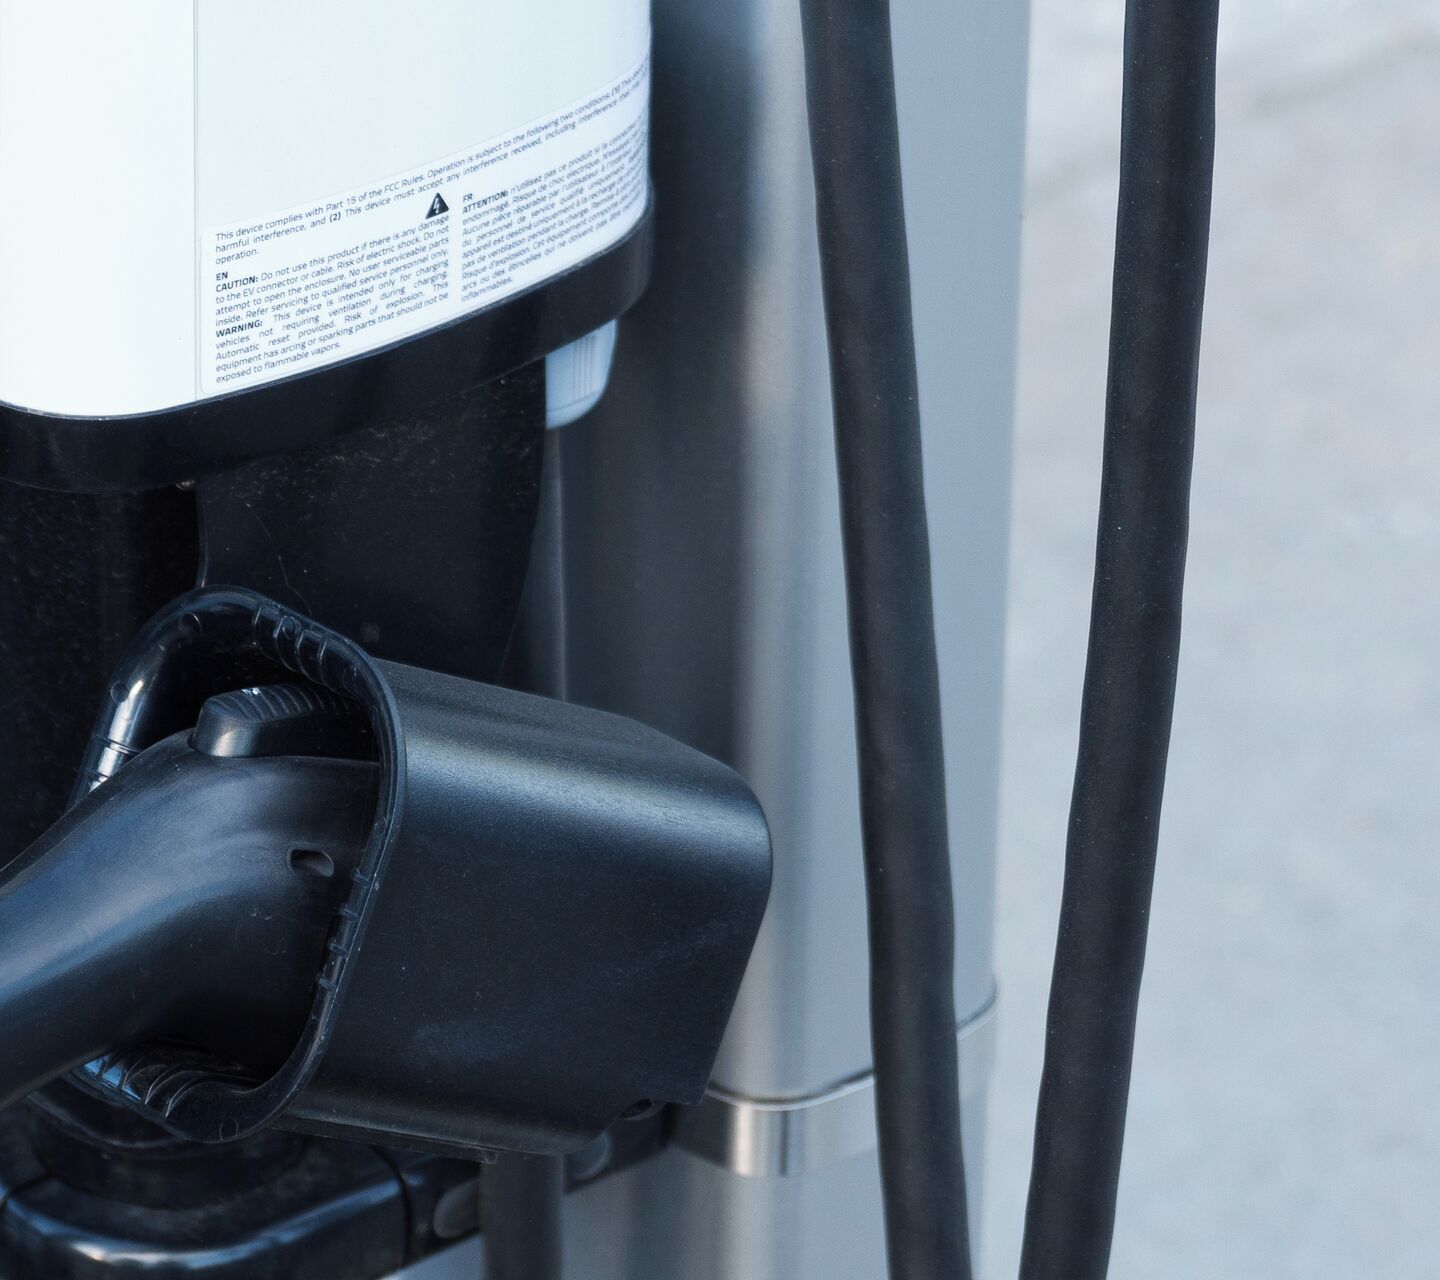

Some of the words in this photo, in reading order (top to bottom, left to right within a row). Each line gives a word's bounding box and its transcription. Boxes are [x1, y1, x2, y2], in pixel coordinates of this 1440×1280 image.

[215, 237, 249, 252] harmful
[309, 216, 326, 227] and
[328, 211, 341, 222] (2)
[342, 206, 363, 216] This
[364, 197, 392, 210] device
[393, 188, 416, 200] must
[417, 177, 444, 192] accept
[445, 172, 461, 182] any
[462, 152, 508, 174] interference
[216, 231, 234, 240] This
[235, 224, 263, 236] device
[264, 213, 304, 229] complies
[304, 207, 324, 217] with
[325, 200, 344, 211] Part
[368, 189, 382, 198] the
[383, 181, 400, 193] FCC
[426, 159, 465, 178] Operation
[474, 143, 503, 159] subject
[512, 134, 525, 143] the
[215, 275, 258, 292] CAUTION:
[274, 267, 290, 276] not
[291, 262, 308, 272] use
[309, 257, 326, 267] this
[326, 246, 360, 263] product
[368, 236, 392, 248] there
[399, 227, 416, 237] any
[417, 215, 450, 231] damage
[215, 249, 259, 264] operation.
[215, 300, 252, 315] attempt
[263, 291, 286, 303] open
[287, 286, 303, 295] the
[303, 274, 346, 291] enclosure.
[361, 261, 381, 272] user
[382, 245, 428, 266] serviceable
[428, 237, 450, 251] parts
[215, 314, 244, 326] inside.
[245, 307, 269, 318] Refer
[270, 296, 309, 312] servicing
[321, 279, 358, 297] qualified
[358, 270, 388, 285] service
[389, 254, 429, 275] personnel
[226, 292, 242, 301] the
[255, 276, 300, 293] connector
[310, 266, 336, 277] cable.
[336, 258, 355, 269] Risk
[365, 245, 396, 260] electric
[435, 225, 450, 235] not
[215, 319, 263, 337] WARNING:
[272, 312, 293, 321] This
[294, 303, 323, 316] device
[337, 285, 374, 302] intended
[376, 278, 397, 289] only
[399, 273, 414, 282] for
[415, 259, 449, 276] charging
[215, 335, 251, 348] vehicles
[258, 328, 274, 337] not
[282, 315, 320, 330] requiring
[327, 298, 372, 316] ventilation
[379, 286, 406, 300] during
[215, 343, 260, 359] Automatic
[267, 334, 290, 345] reset
[344, 311, 362, 323] Risk
[431, 281, 448, 291] This
[215, 353, 262, 371] equipment
[263, 349, 280, 358] has
[279, 341, 306, 354] arcing
[317, 326, 354, 342] sparking
[354, 318, 376, 332] parts
[377, 311, 395, 323] that
[395, 300, 423, 316] should
[423, 295, 438, 306] not
[215, 367, 252, 383] exposed
[263, 351, 310, 369] flammable
